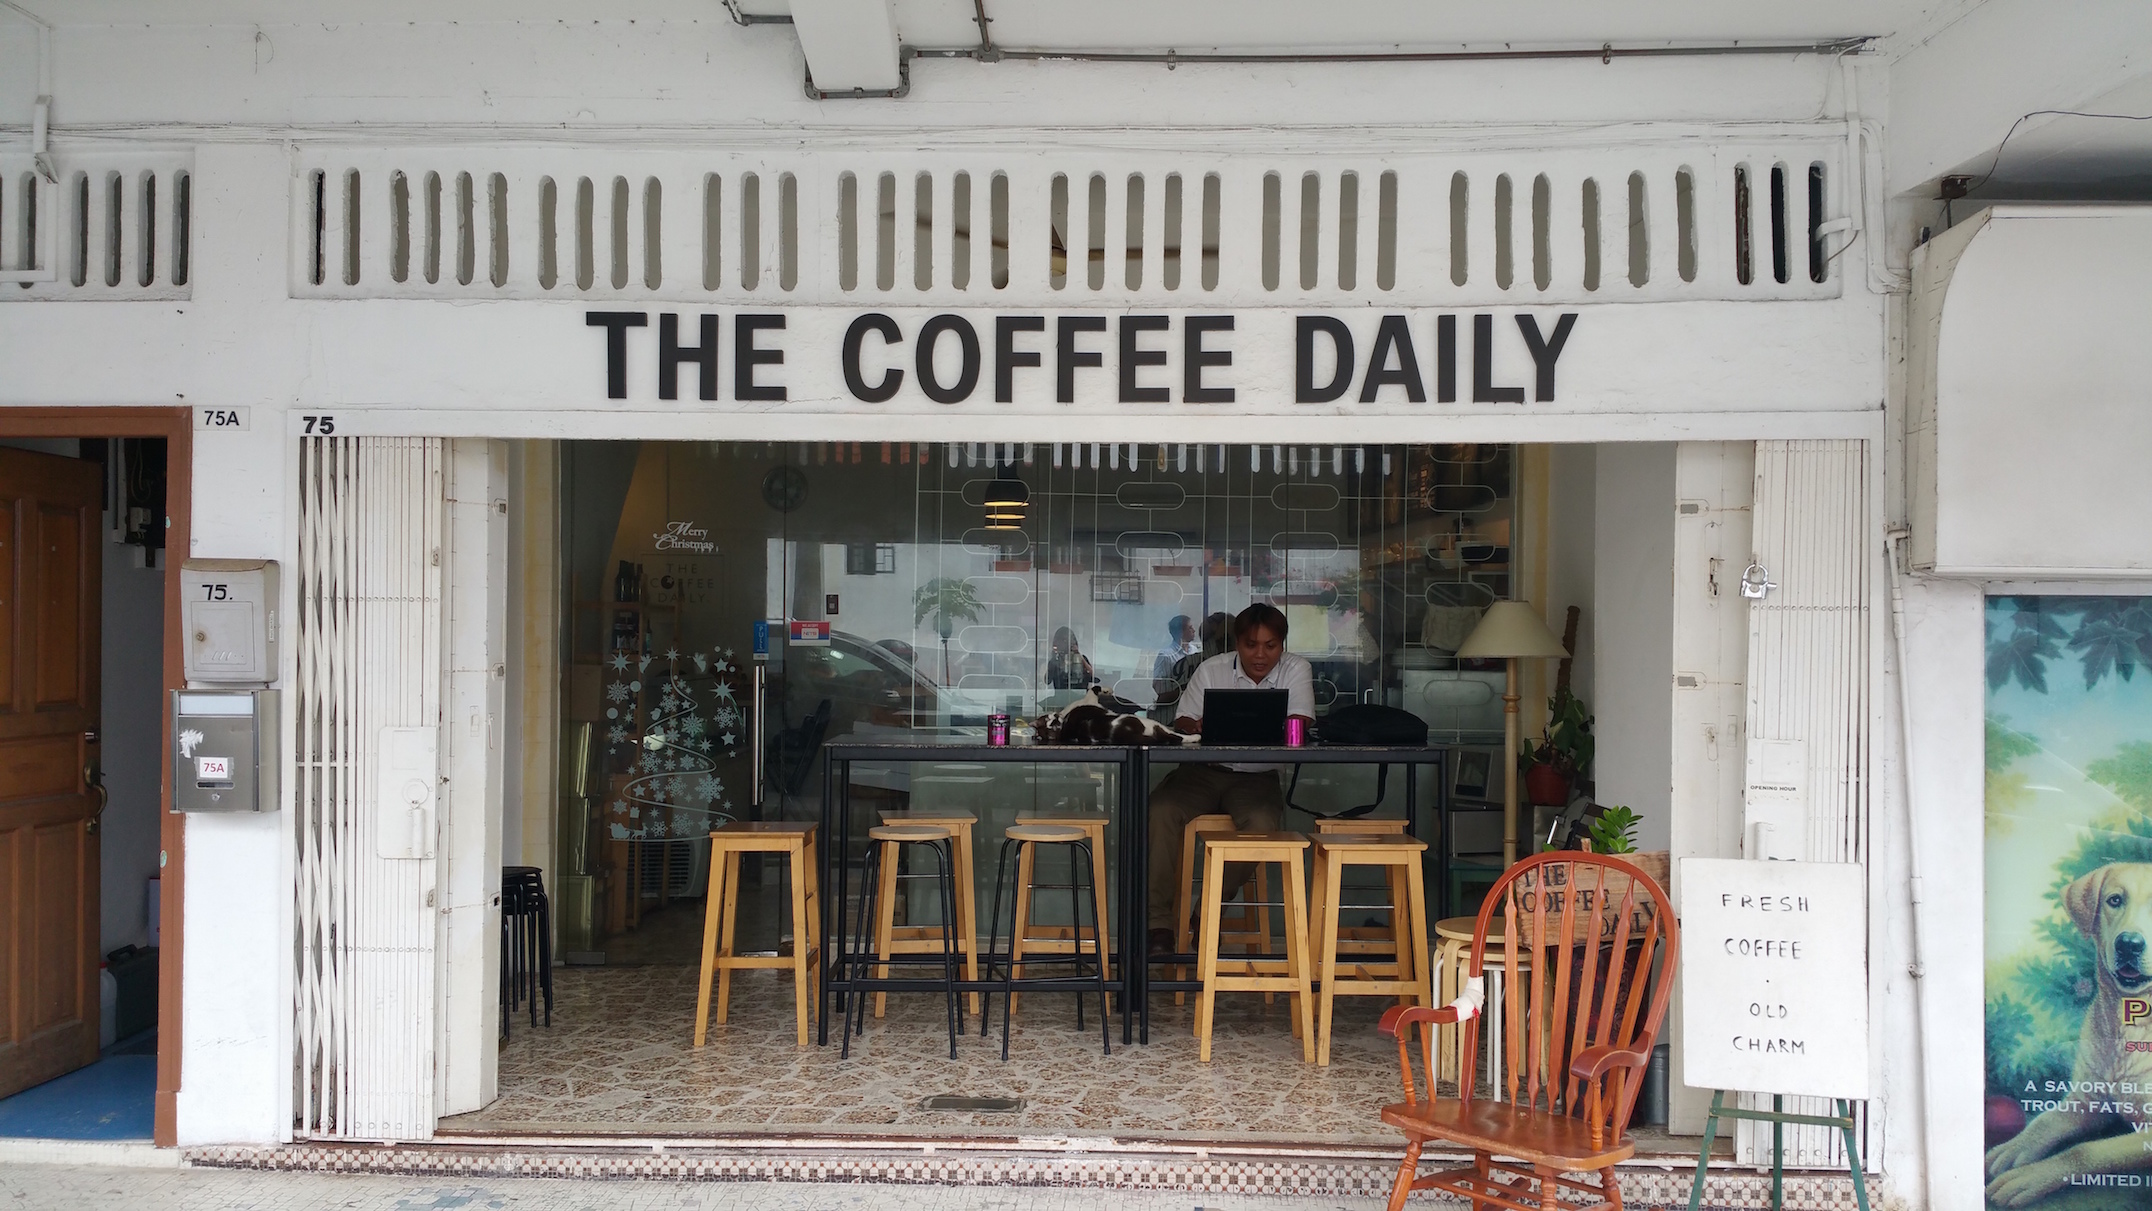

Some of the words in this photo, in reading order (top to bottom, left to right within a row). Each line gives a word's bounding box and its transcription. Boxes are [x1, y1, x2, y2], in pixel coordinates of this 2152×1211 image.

[586, 312, 787, 401] THE
[842, 313, 1235, 403] COFFEE
[1296, 313, 1578, 403] DAILY
[204, 411, 239, 426] 75A
[303, 416, 335, 435] 75
[666, 521, 708, 540] Merry
[653, 534, 715, 551] Christmas
[666, 563, 697, 574] THE
[204, 763, 225, 773] 75A
[1722, 894, 1809, 912] FRESH
[1724, 938, 1802, 960] COFFEE
[1750, 1003, 1788, 1019] OLD
[1732, 1036, 1806, 1055] CHARM
[2125, 1041, 2152, 1052] SU
[2024, 1080, 2037, 1092] A
[2045, 1080, 2117, 1094] SAVORY
[2021, 1099, 2085, 1114] TROUT,
[2089, 1101, 2138, 1115] FATS,
